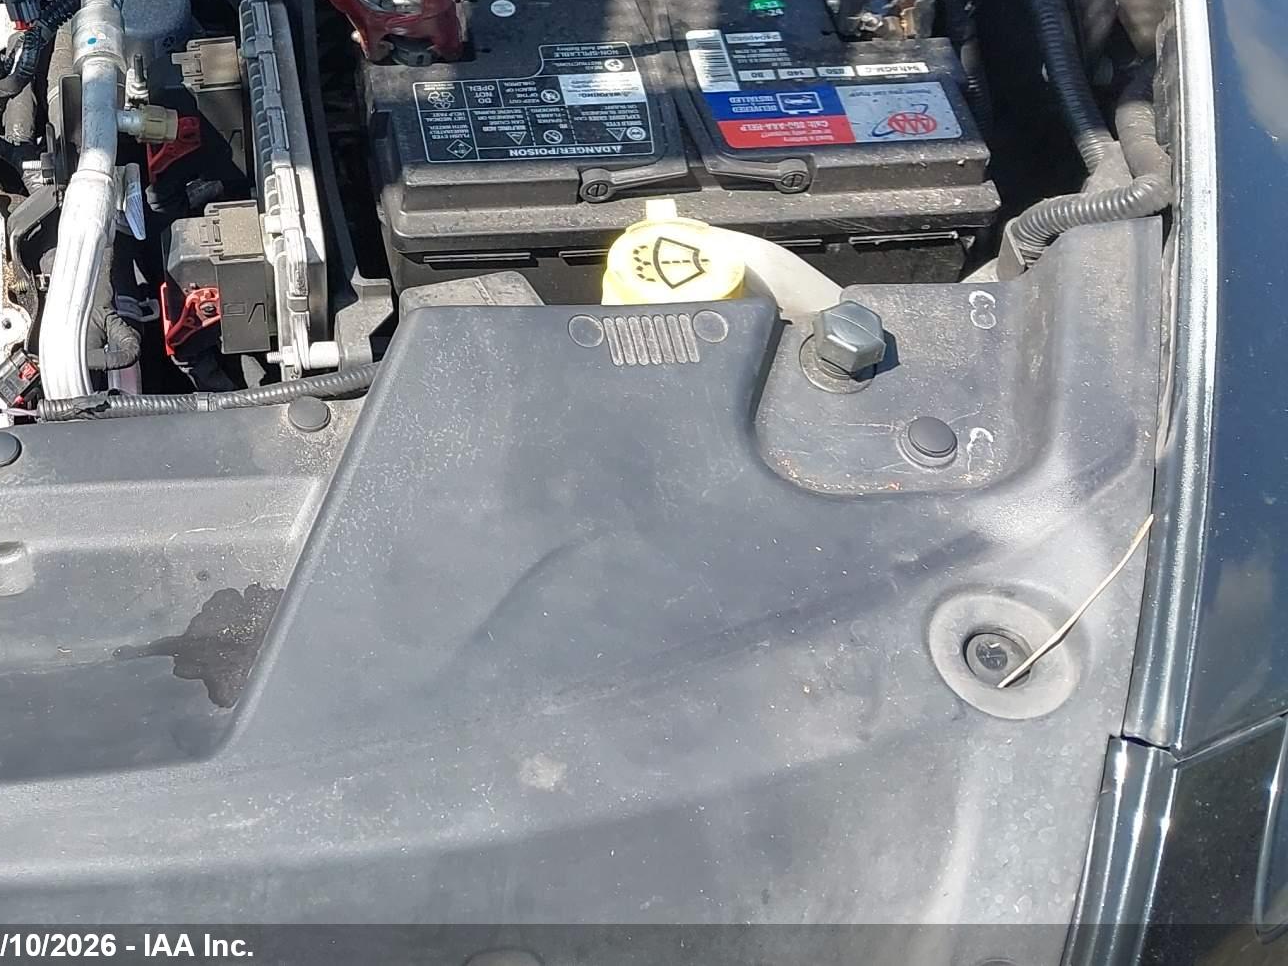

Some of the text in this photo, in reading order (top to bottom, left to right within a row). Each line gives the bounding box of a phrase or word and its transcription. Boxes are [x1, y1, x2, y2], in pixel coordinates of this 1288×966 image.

[728, 96, 773, 104] INSTALLED
[731, 105, 777, 113] DELIVERED
[892, 115, 933, 133] AAA
[509, 145, 612, 156] DANGER/POISON
